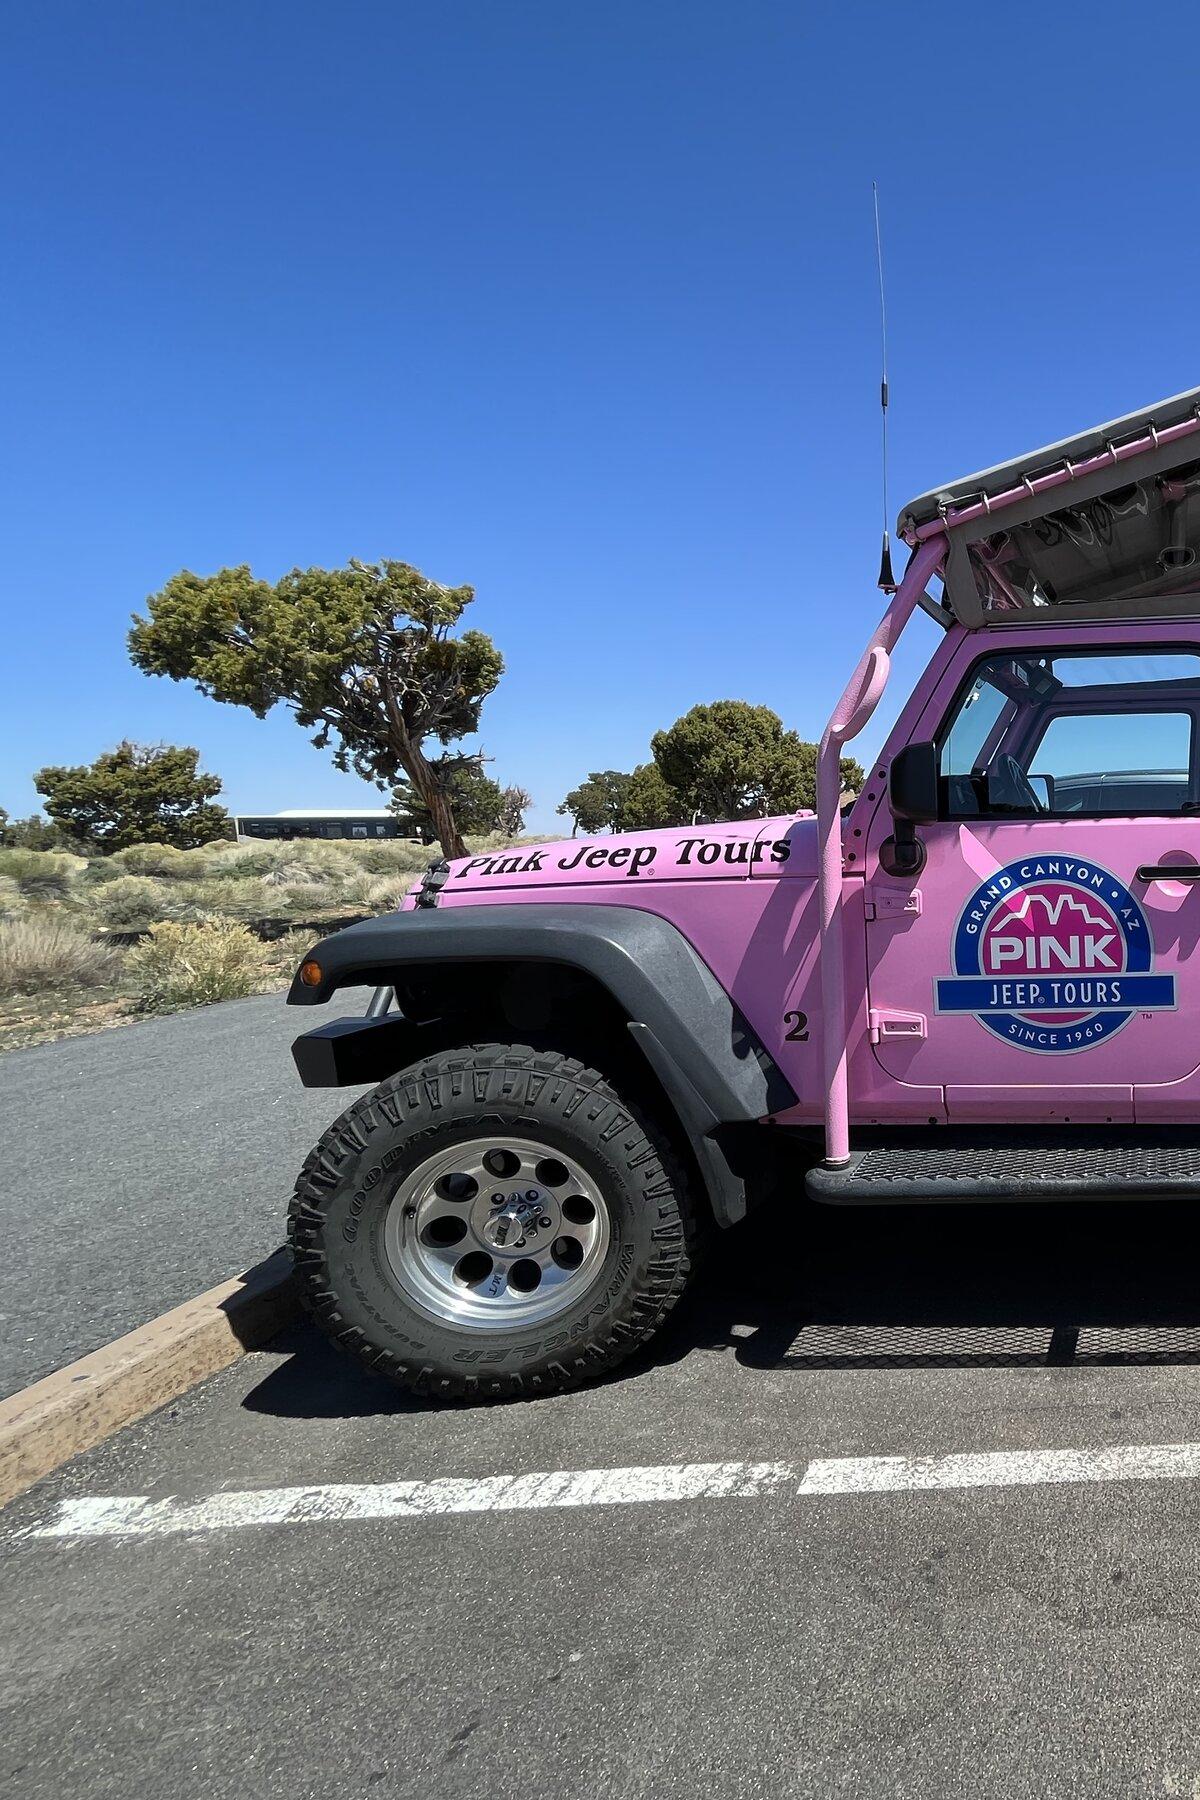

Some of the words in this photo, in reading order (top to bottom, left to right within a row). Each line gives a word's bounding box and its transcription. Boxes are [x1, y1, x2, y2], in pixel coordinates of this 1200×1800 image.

[455, 849, 549, 878] Pink
[675, 838, 792, 865] Tours
[966, 876, 1012, 934] GRAND
[1020, 862, 1104, 888] CANYON
[1120, 907, 1140, 931] AZ
[989, 934, 1118, 970] PINK
[1050, 981, 1122, 1004] TOURS
[783, 1010, 810, 1042] 2
[1008, 1023, 1058, 1044] SINCE
[1065, 1022, 1104, 1043] 1960
[452, 1243, 636, 1364] WRANGLER
